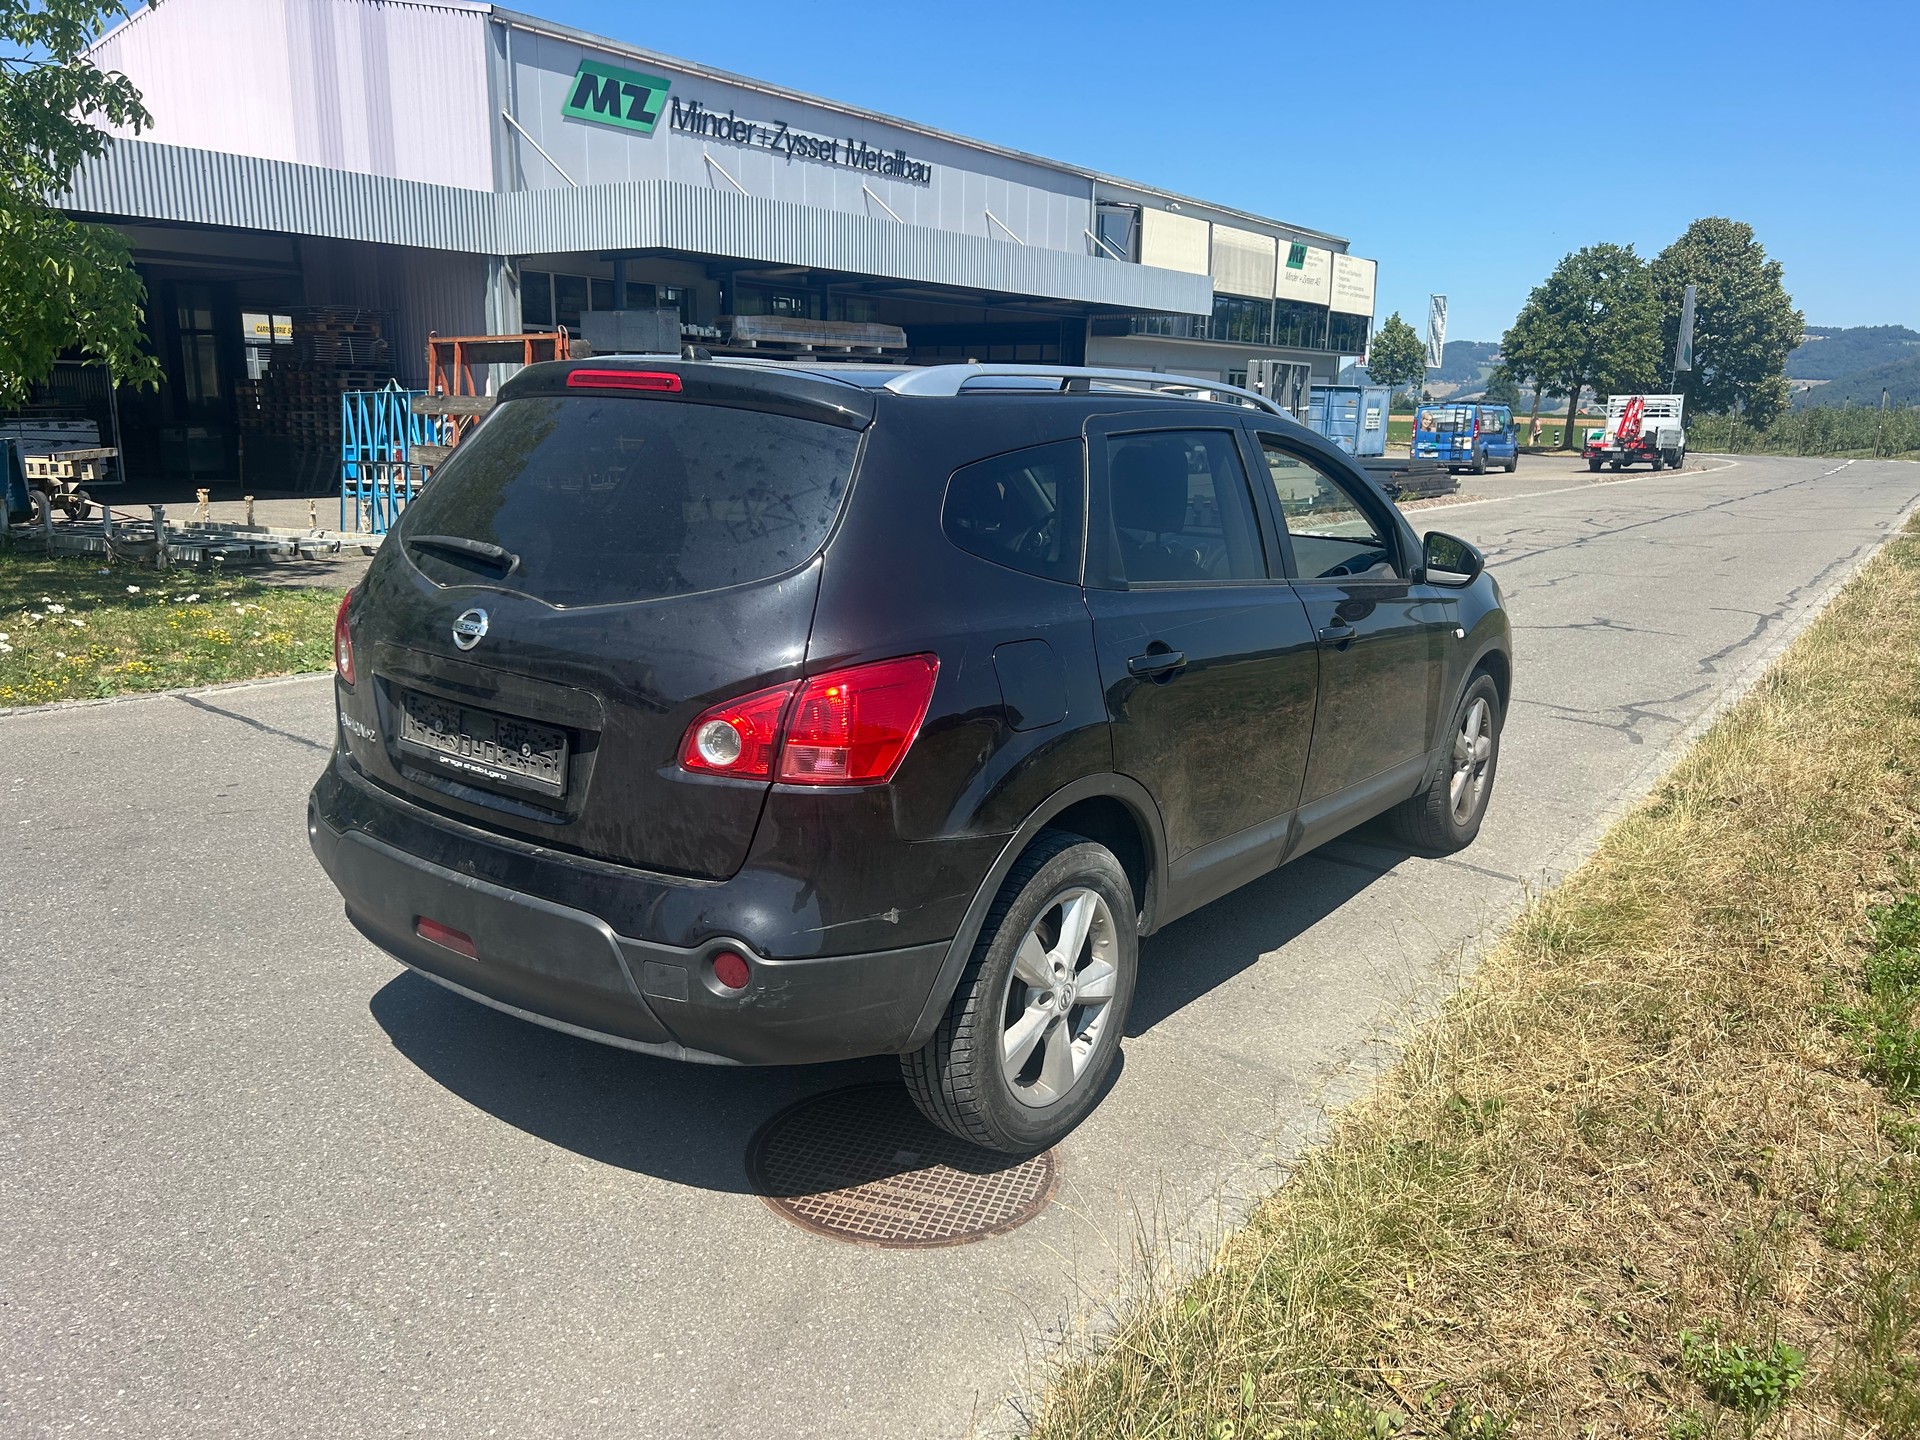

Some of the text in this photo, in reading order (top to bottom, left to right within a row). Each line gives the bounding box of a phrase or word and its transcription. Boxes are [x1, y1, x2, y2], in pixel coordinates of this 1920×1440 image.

[570, 73, 656, 125] MZ
[845, 137, 931, 184] Metallbau
[834, 1198, 912, 1219] OBERBURG
